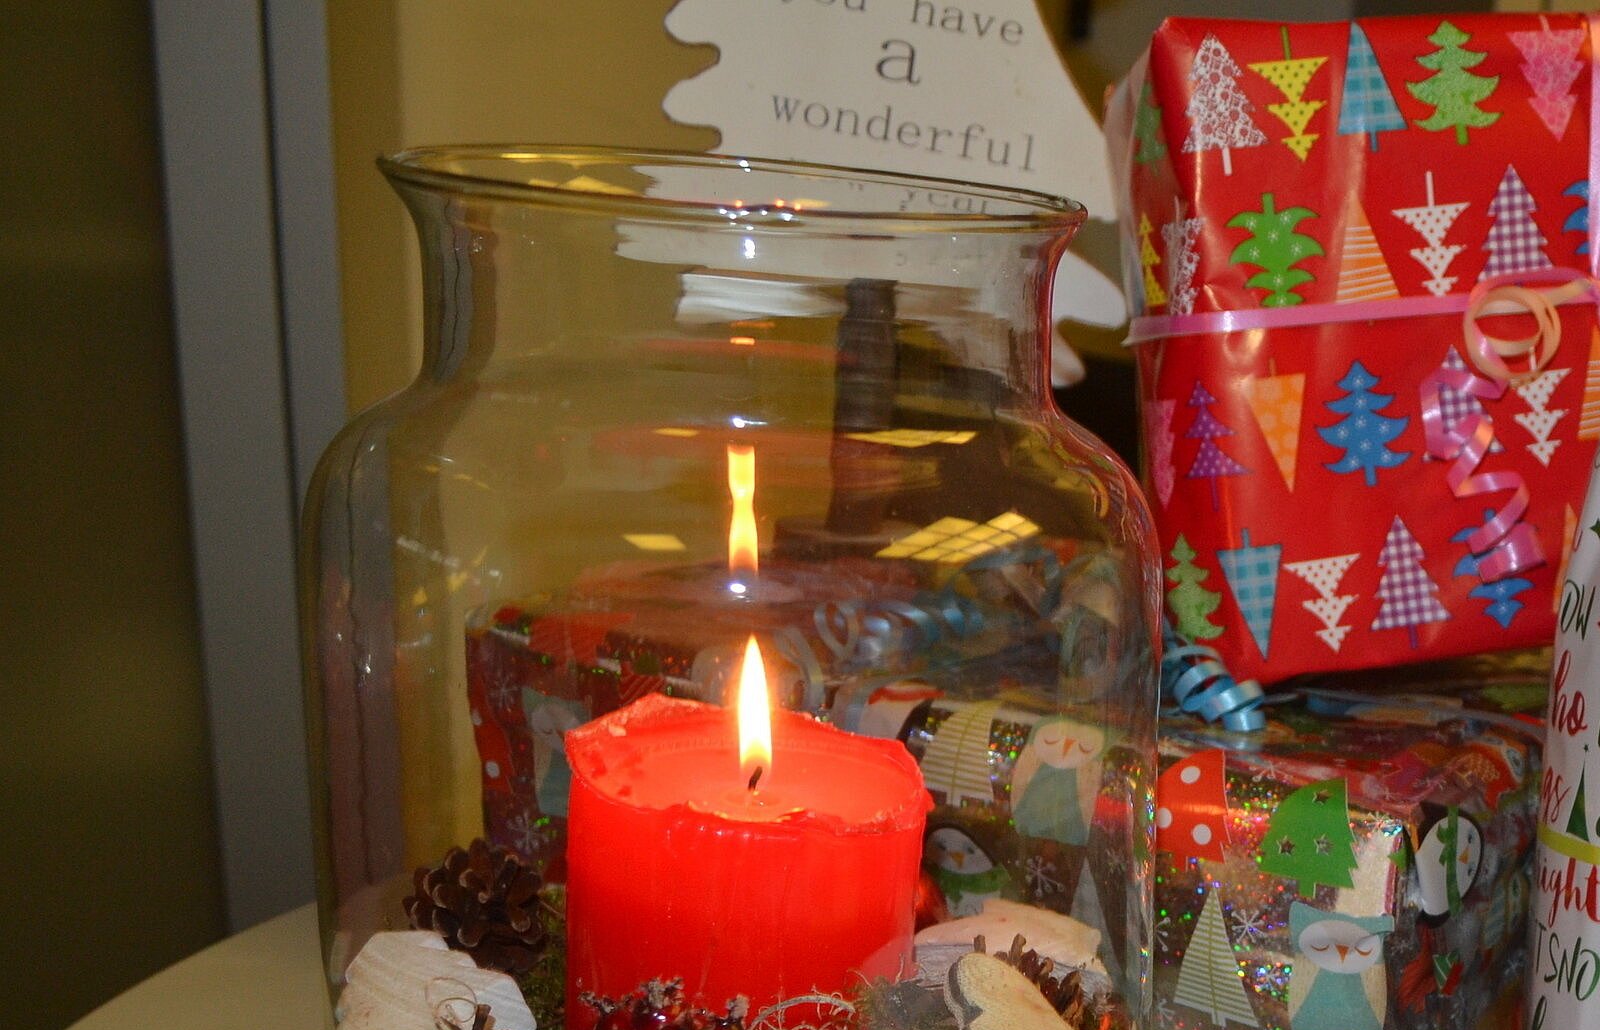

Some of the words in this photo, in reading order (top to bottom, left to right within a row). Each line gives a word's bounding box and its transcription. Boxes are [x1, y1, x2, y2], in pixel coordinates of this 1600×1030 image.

[911, 0, 1024, 46] have
[876, 38, 921, 85] a
[771, 94, 1037, 173] wonderful
[1551, 649, 1589, 737] ho
